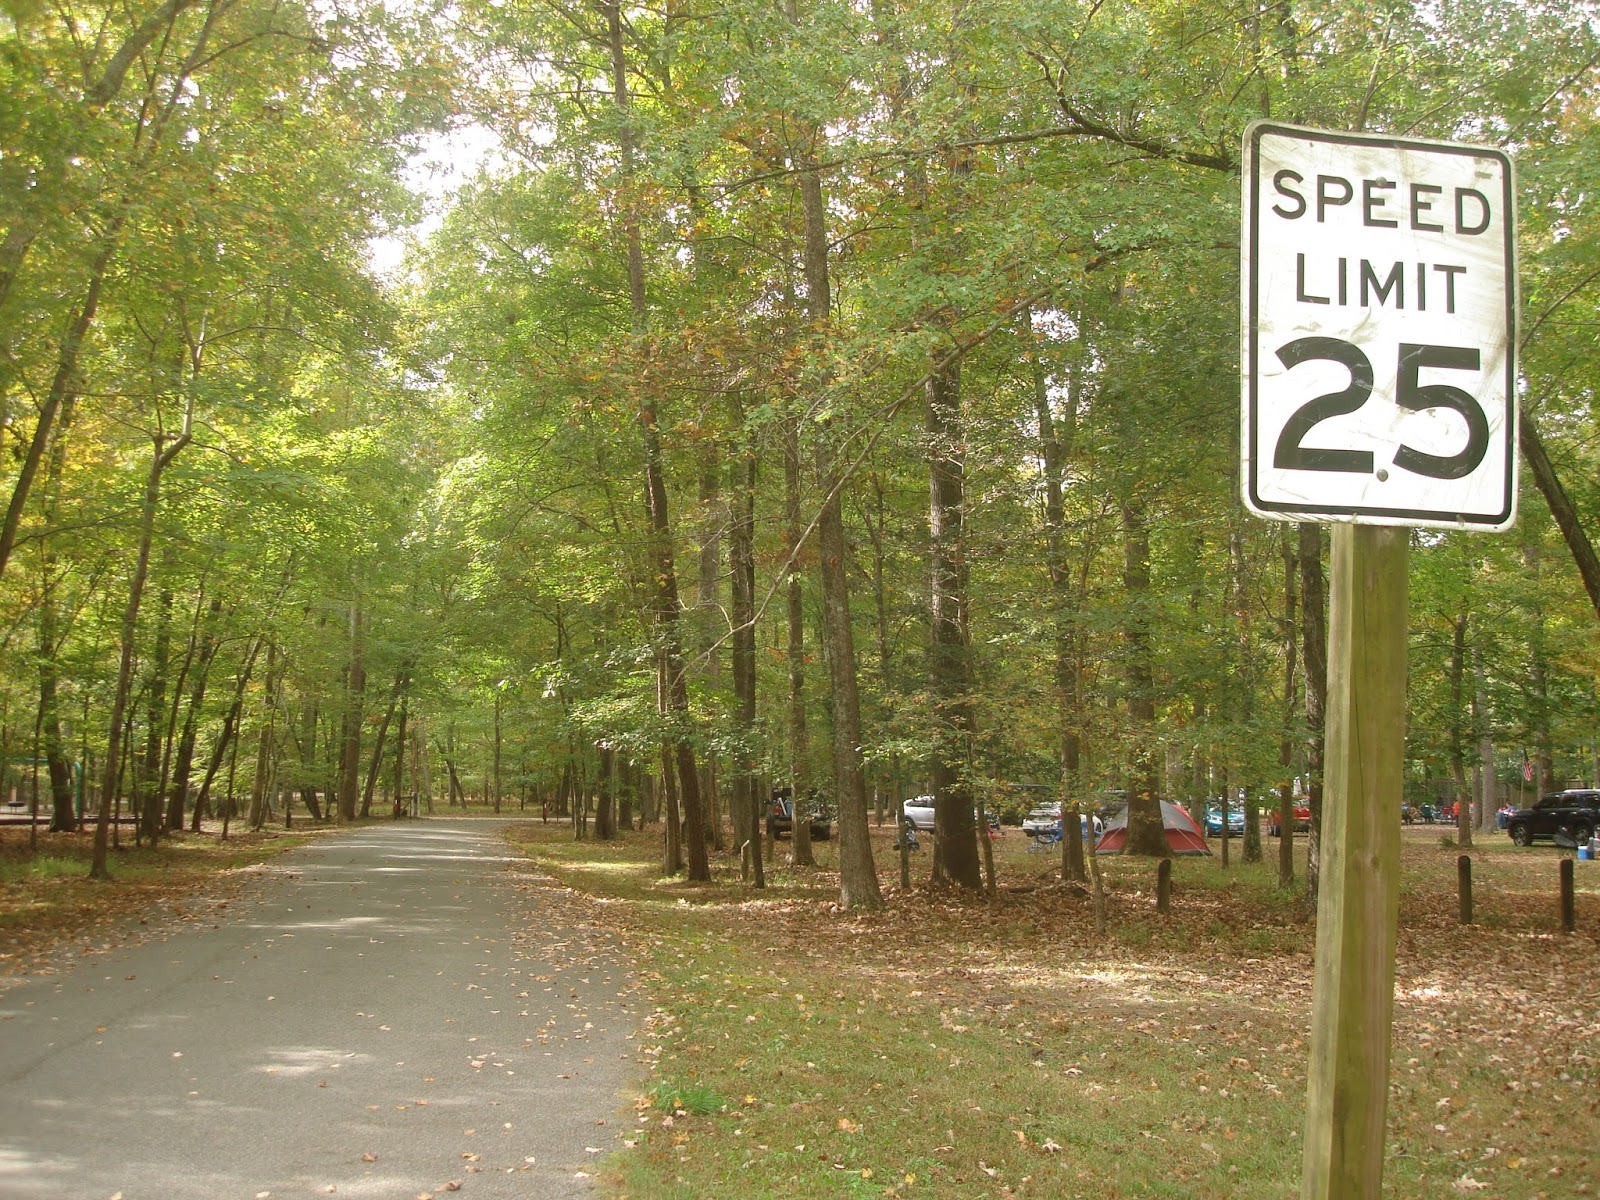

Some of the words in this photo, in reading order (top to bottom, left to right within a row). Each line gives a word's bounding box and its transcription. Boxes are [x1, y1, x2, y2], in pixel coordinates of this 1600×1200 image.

[1271, 169, 1491, 236] SPEED
[1296, 253, 1467, 314] LIMIT
[1273, 336, 1490, 480] 25
